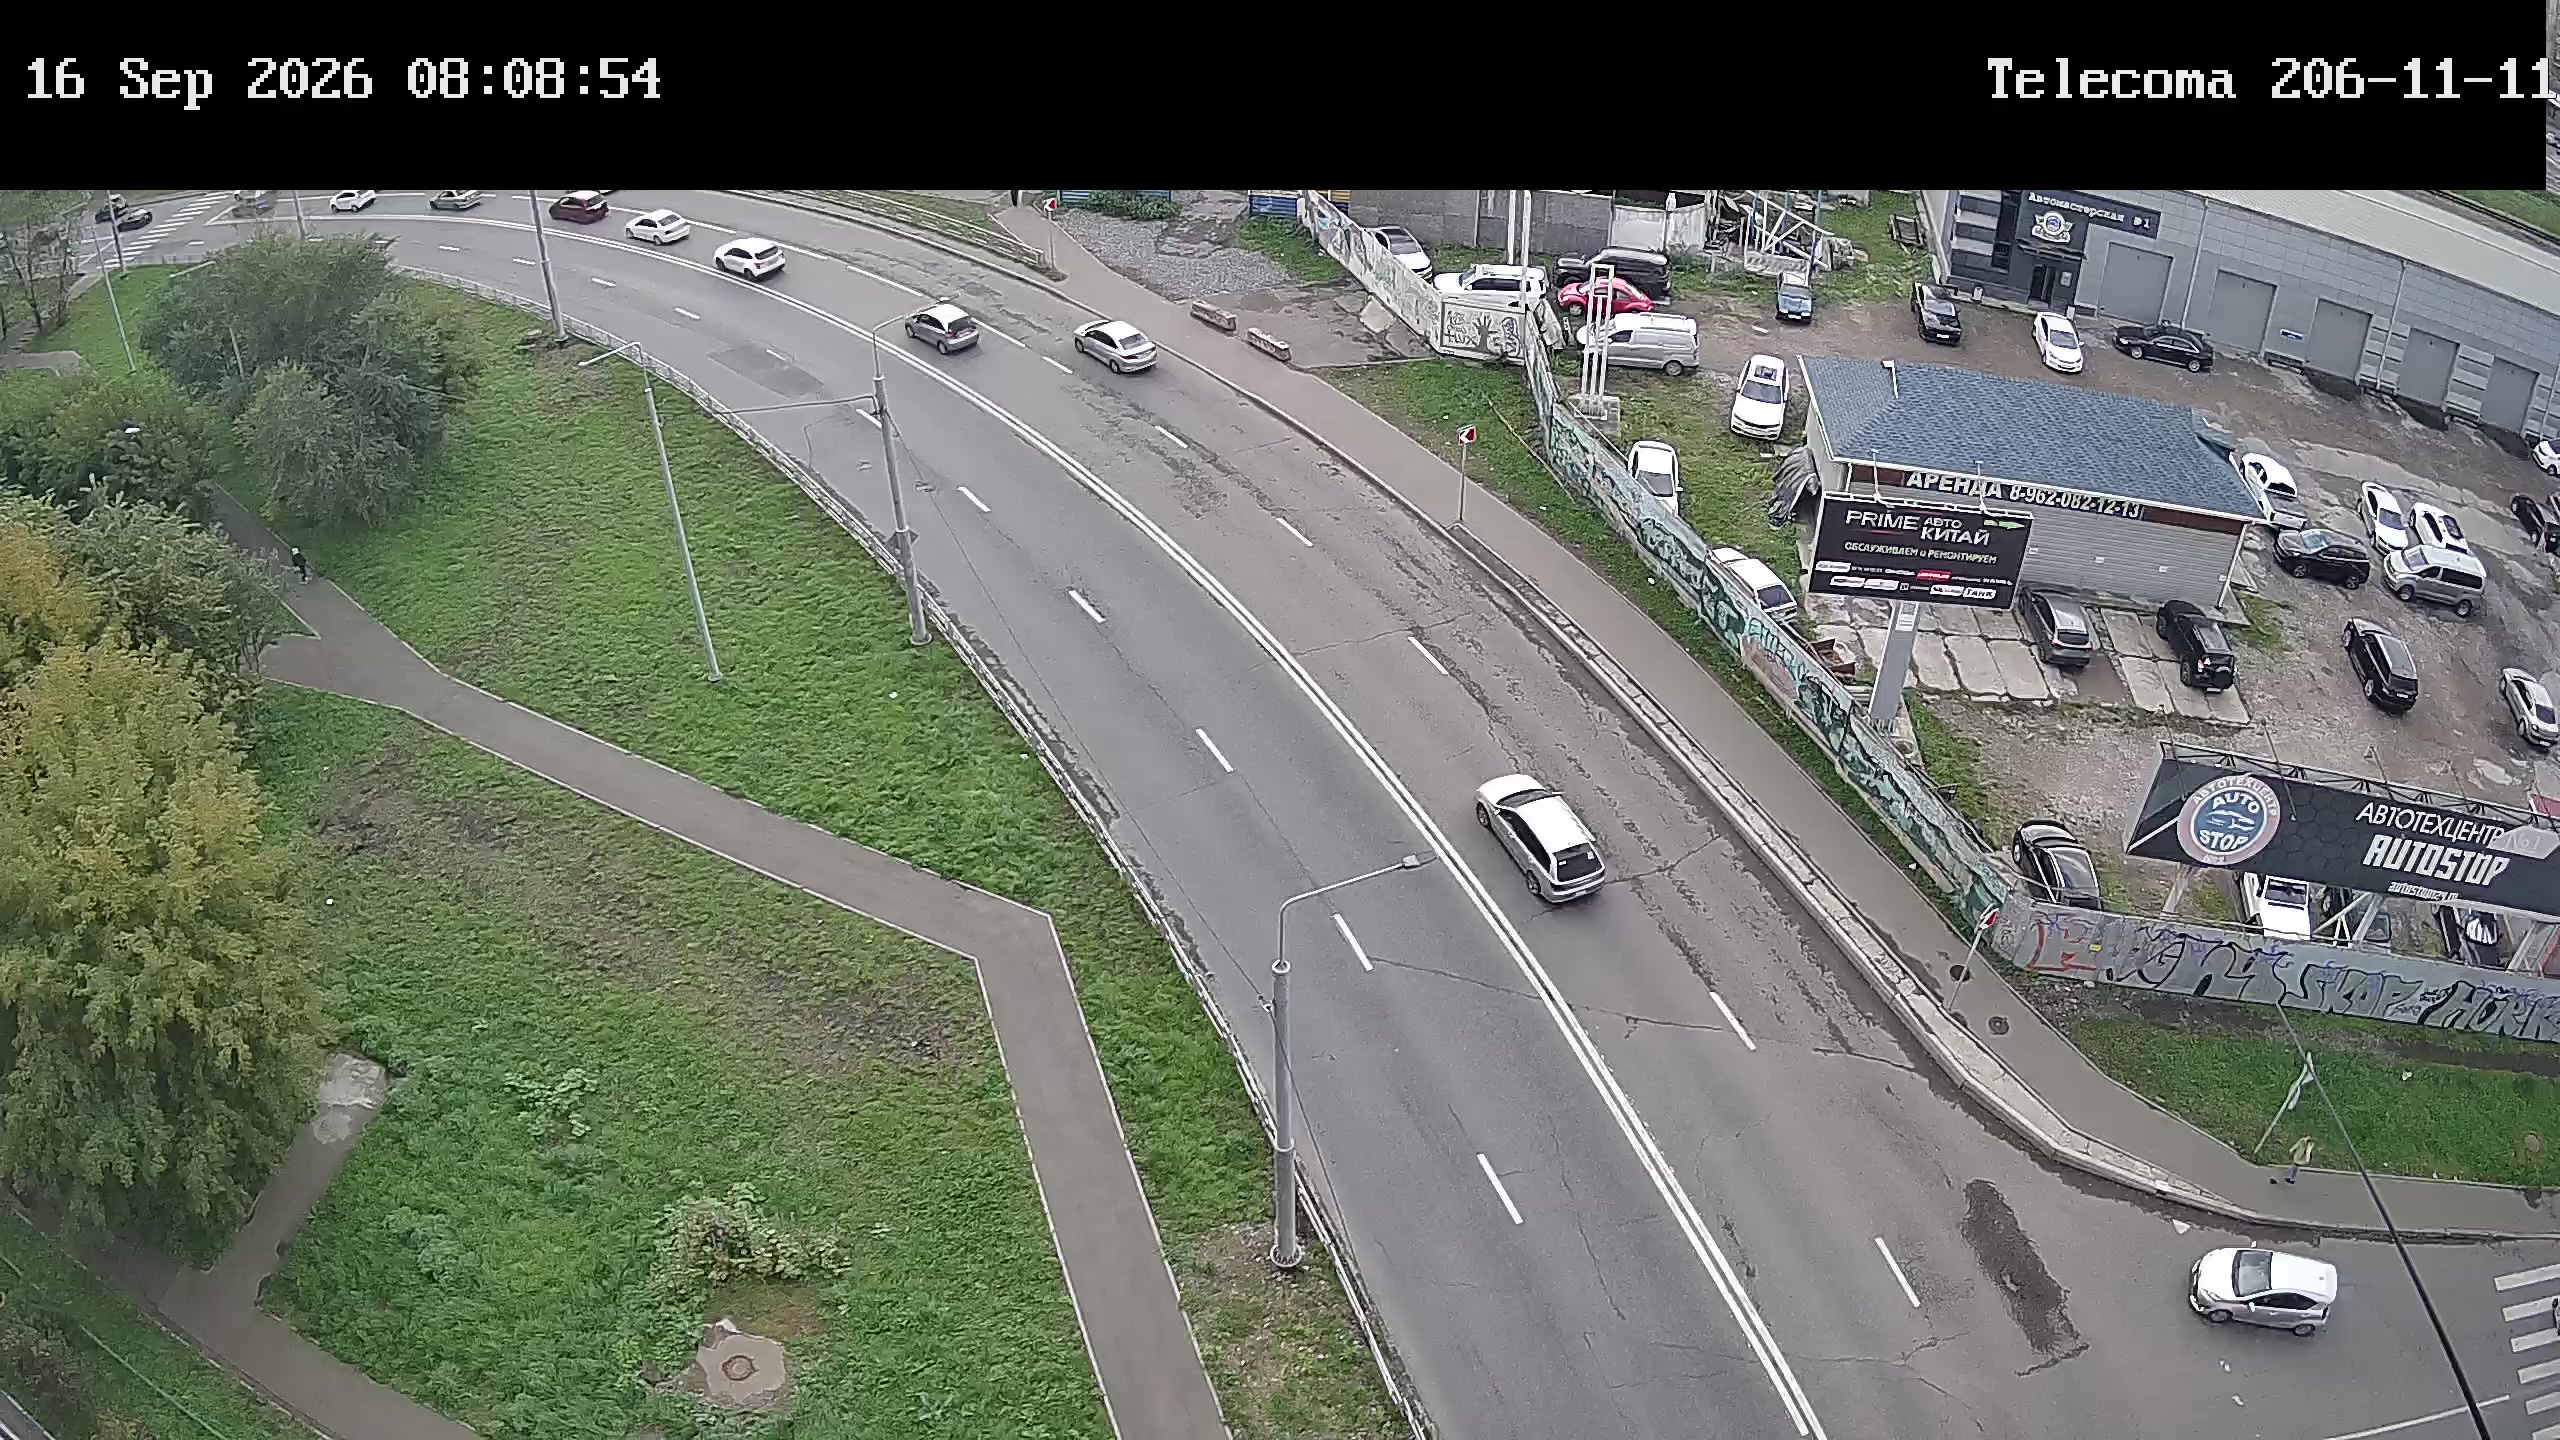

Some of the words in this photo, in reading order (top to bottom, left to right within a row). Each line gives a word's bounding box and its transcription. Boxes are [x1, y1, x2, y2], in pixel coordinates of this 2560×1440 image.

[2028, 191, 2125, 223] Автомастерская
[1906, 470, 2002, 499] АРЕНДА
[1845, 509, 1921, 531] PRIME
[1924, 516, 1963, 529] АВТО
[1920, 526, 1991, 546] КИТАЙ
[1928, 549, 1998, 564] РЕМОНТИРУЕМ
[2211, 791, 2260, 814] AUTO
[2355, 801, 2506, 846] АВТОТЕХЦЕНТР
[2199, 829, 2249, 851] STOP
[2362, 833, 2511, 886] AUTOSTOP
